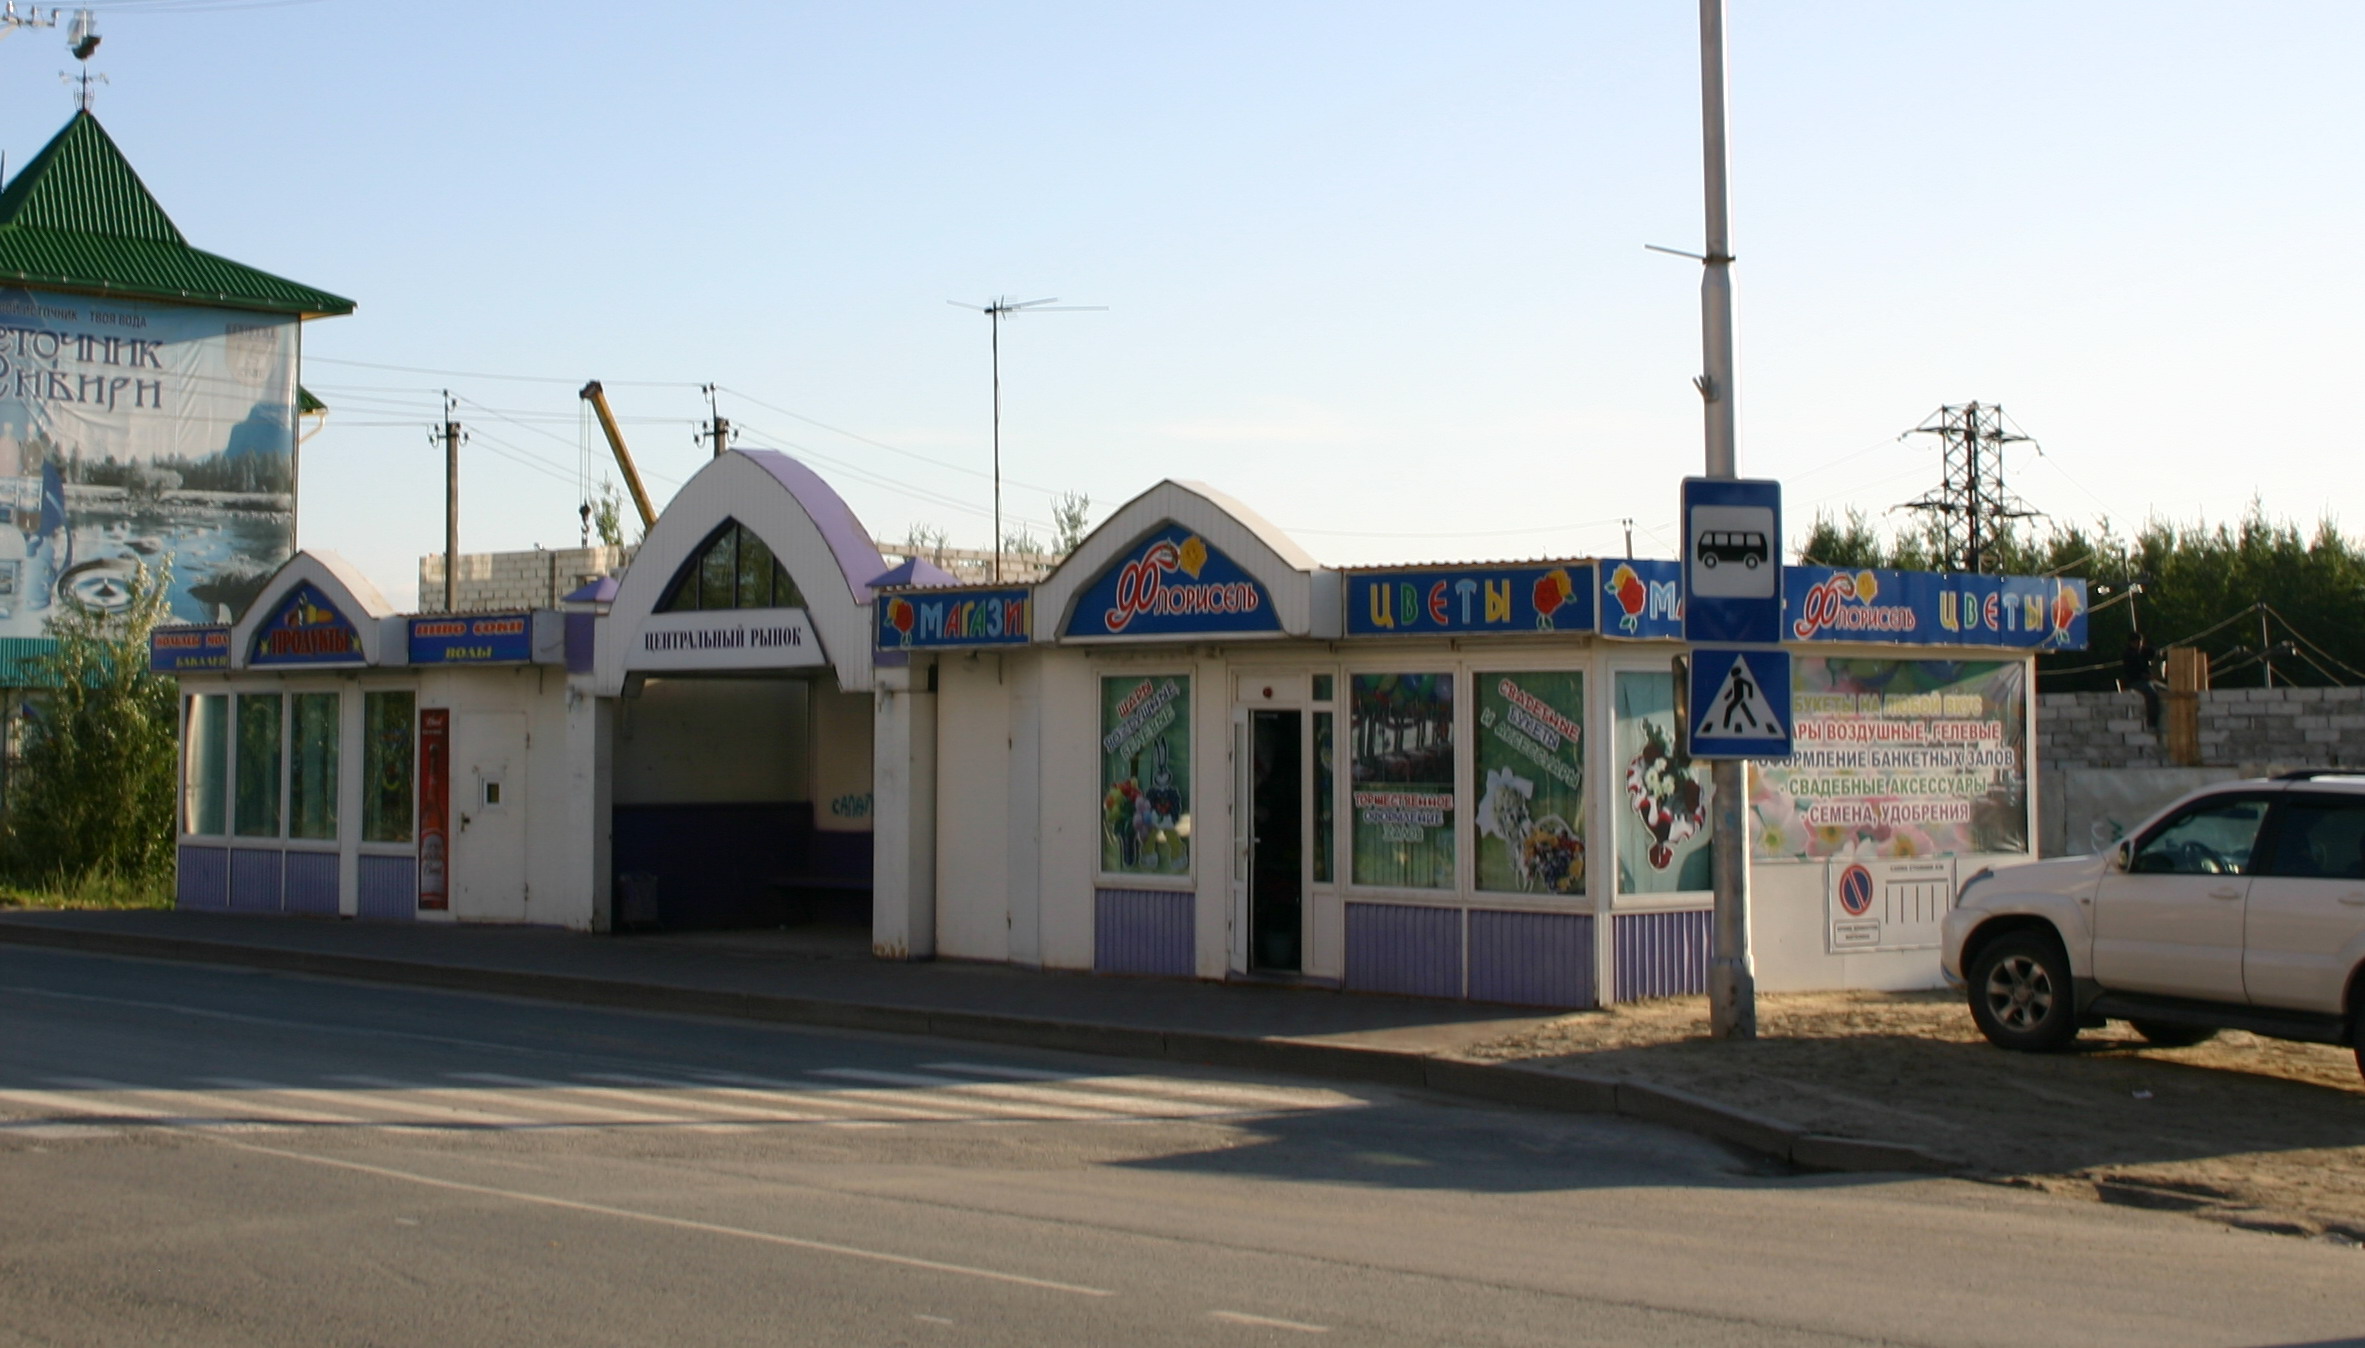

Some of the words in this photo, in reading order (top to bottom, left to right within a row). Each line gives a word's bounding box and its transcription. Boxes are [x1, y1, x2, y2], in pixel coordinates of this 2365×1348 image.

[89, 311, 117, 325] ТВОЯ
[118, 314, 147, 328] ВОДА
[1104, 541, 1258, 632] ФЛОРИСЕЛЬ
[1369, 578, 1511, 629] ЦВЕТЫ
[1794, 571, 1916, 639] ФЛОРИСЕЛЬ
[1939, 591, 2044, 632] ЦВЕТЫ
[473, 618, 524, 636] СОКИ
[645, 624, 745, 653] ЦЕНТРАЛЬНЫЙ
[751, 627, 801, 648] РЫНОК
[271, 628, 349, 656] ПРОДУКТЫ
[446, 646, 492, 659] ВОДЫ
[1794, 694, 1856, 713] БУКЕТЫ
[1859, 694, 1881, 713] НА
[1884, 690, 1941, 716] ЛЮБОЙ
[1944, 694, 1983, 716] ВКУС
[1827, 722, 1929, 745] ВОЗДУШНЫЕ,
[1932, 722, 2001, 741] ГЕЛЕВЫЕ
[1871, 750, 1963, 768] БАНКЕТНЫХ
[1967, 748, 2014, 767] ЗАЛОВ
[1789, 778, 1885, 798] СВАДЕБНЫЕ
[1890, 777, 1987, 796] АКСЕССУАРЫ
[1809, 806, 1878, 826] СЕМЕНА,
[1882, 803, 1969, 824] УДОБРЕНИЯ
